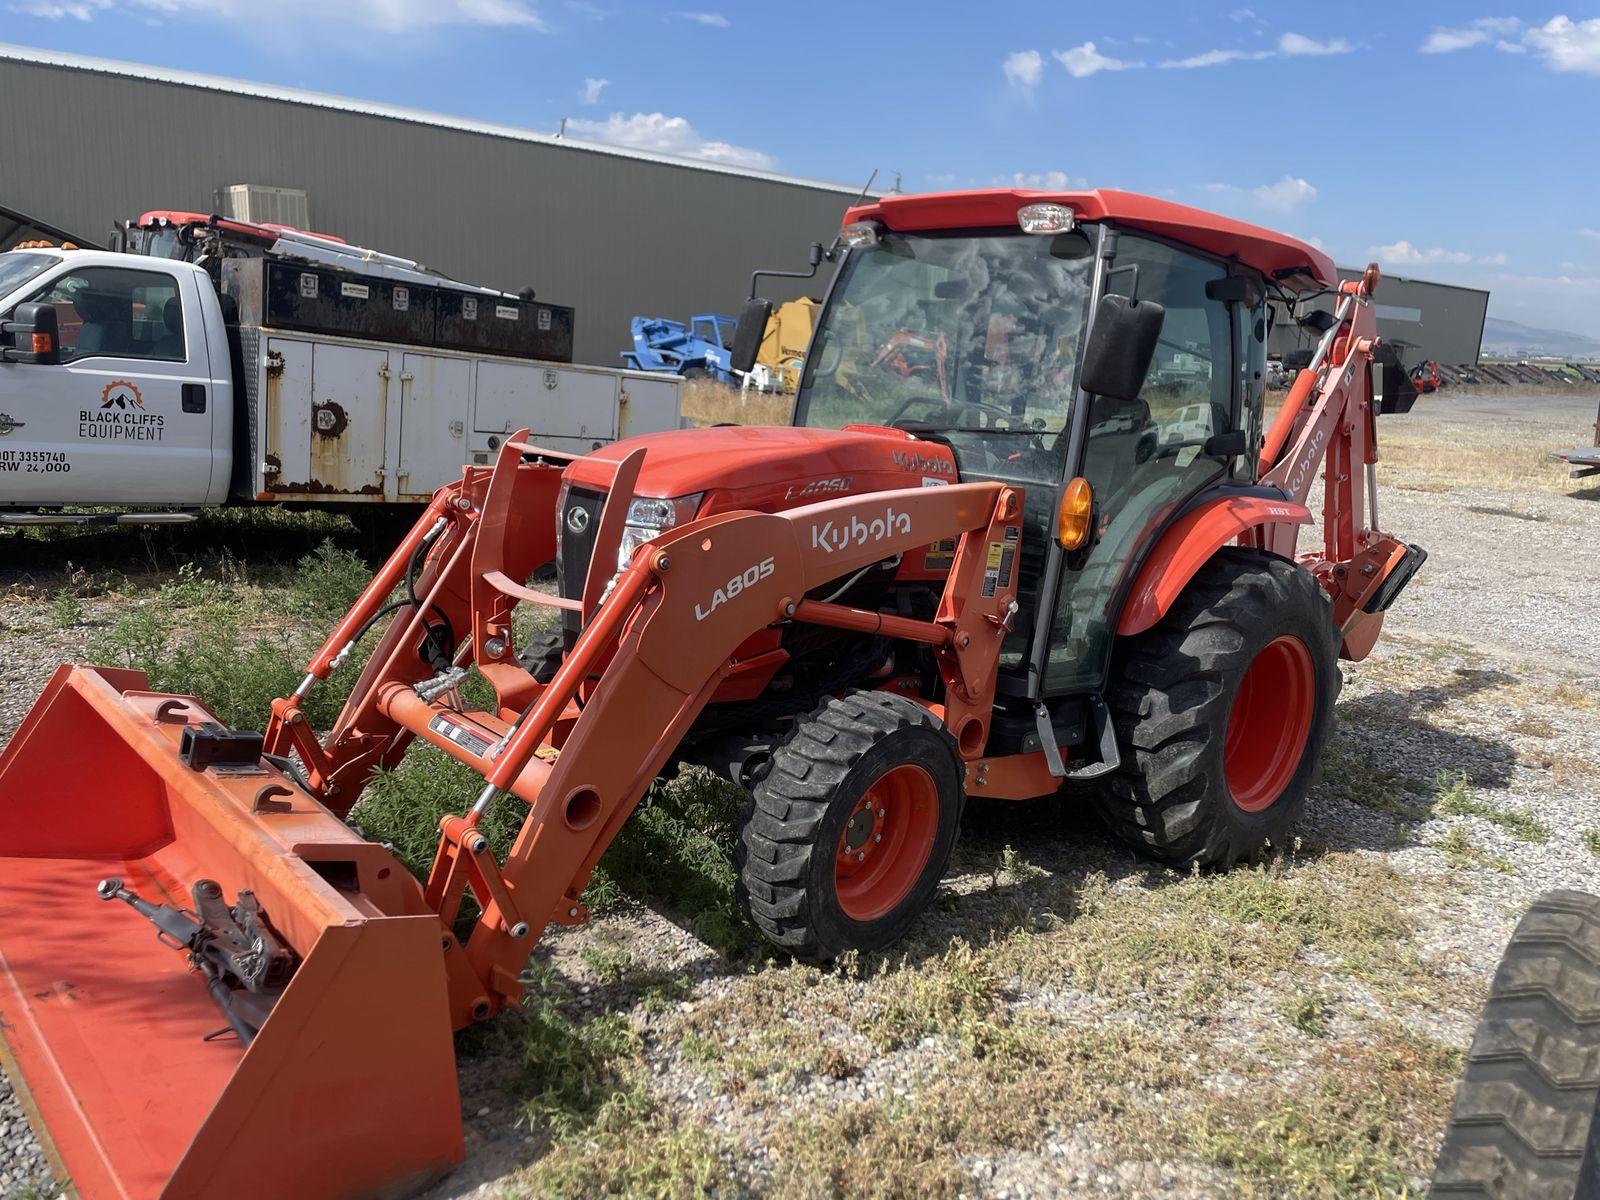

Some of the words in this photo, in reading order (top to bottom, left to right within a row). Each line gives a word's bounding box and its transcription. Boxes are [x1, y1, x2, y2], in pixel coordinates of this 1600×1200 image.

[79, 411, 120, 423] BLACK
[124, 413, 164, 426] CLIFFS
[79, 423, 164, 440] EQUIPMENT
[0, 450, 16, 461] OT
[19, 451, 66, 462] 3355740
[891, 448, 954, 475] Kubota
[812, 507, 911, 552] Kubota
[694, 556, 775, 621] LA805
